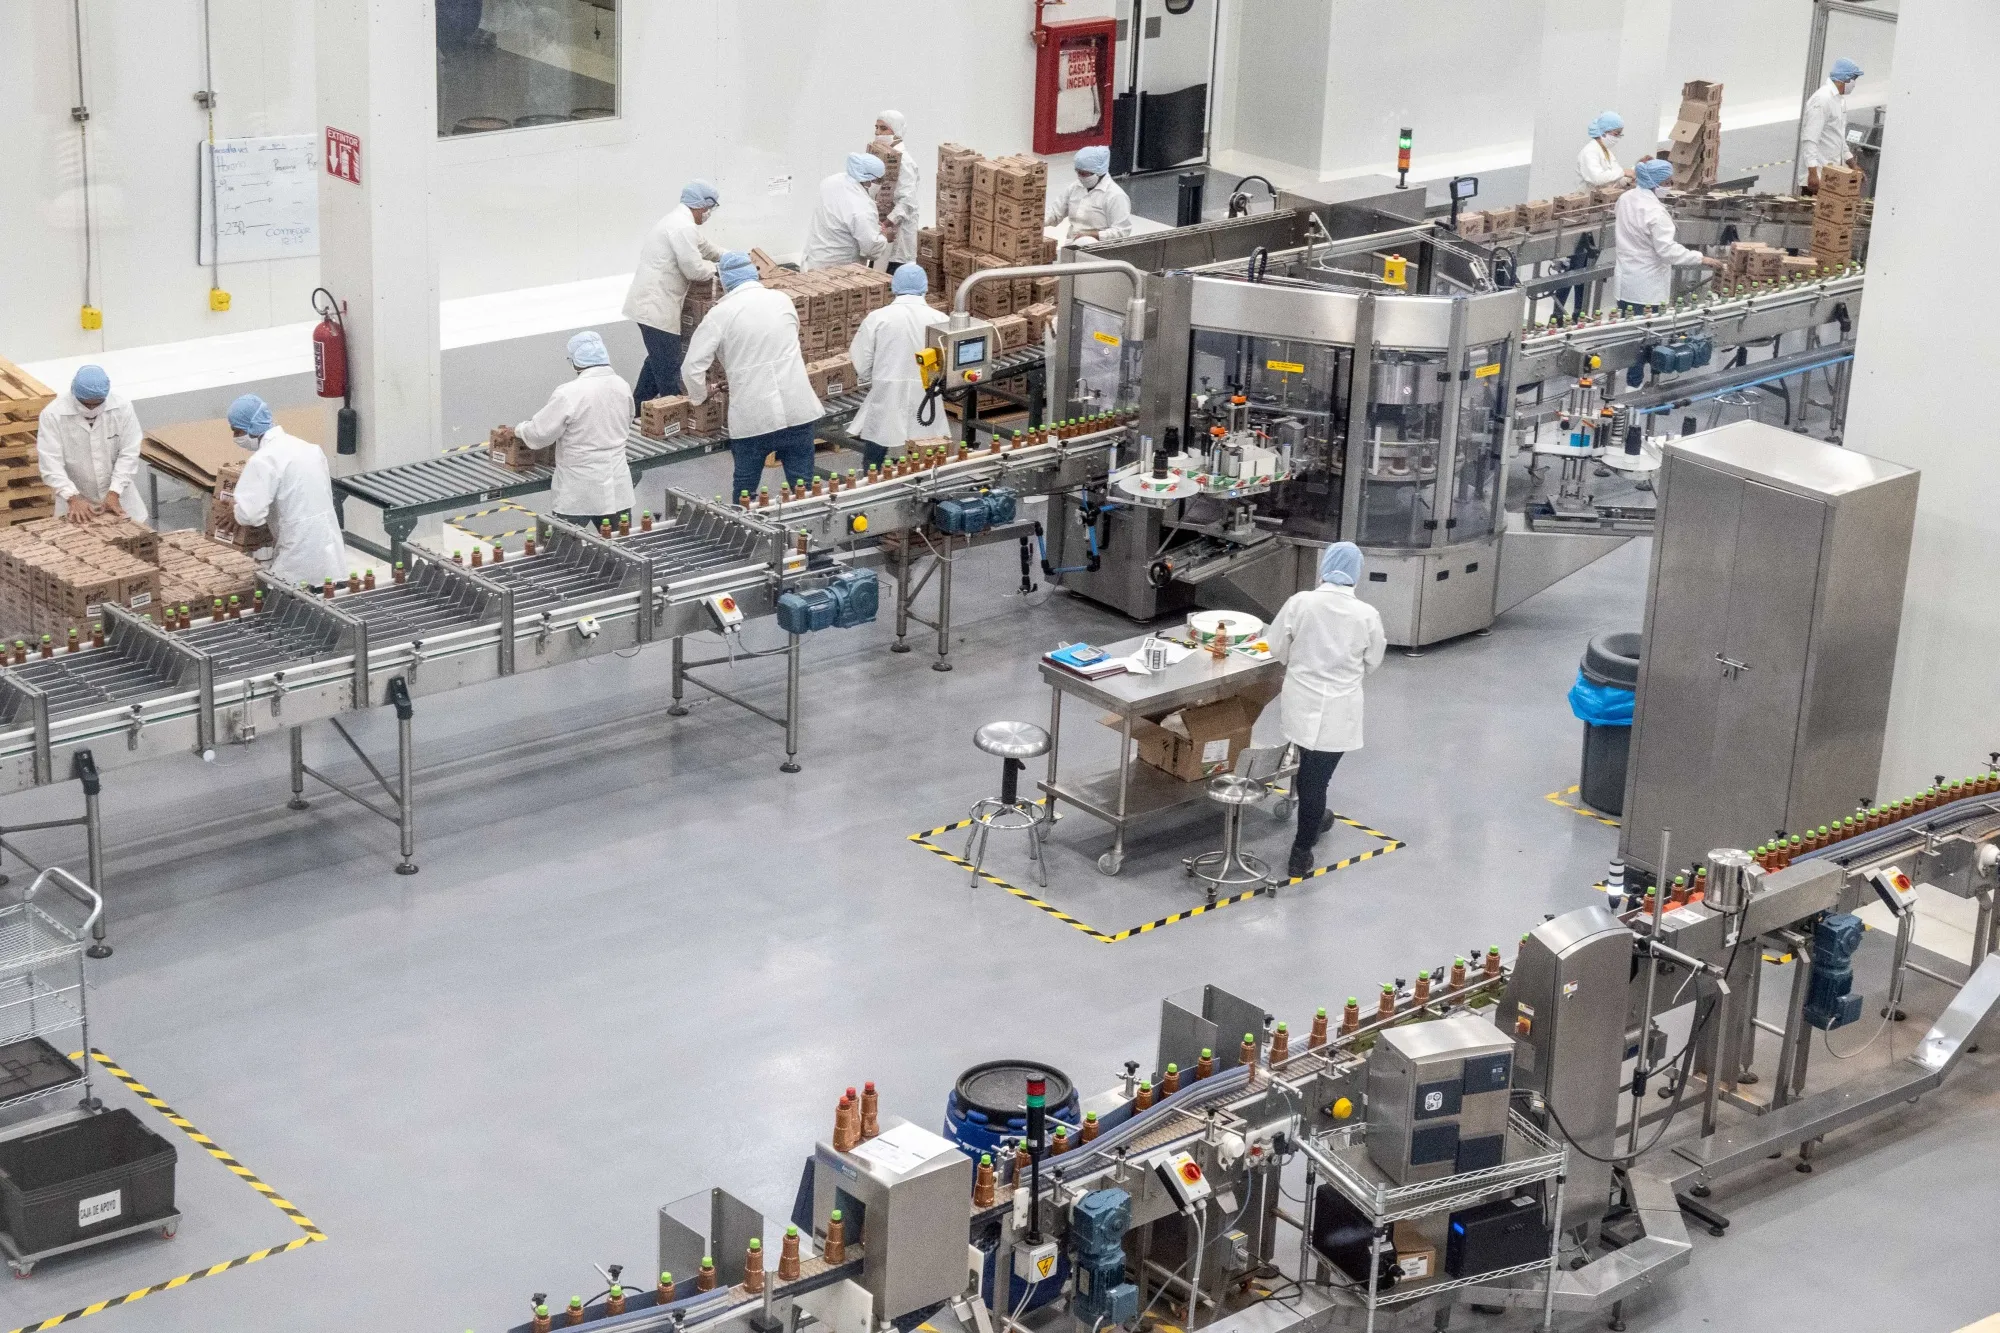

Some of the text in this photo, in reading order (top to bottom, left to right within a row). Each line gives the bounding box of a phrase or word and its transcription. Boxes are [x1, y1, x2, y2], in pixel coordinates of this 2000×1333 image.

[1069, 62, 1096, 76] CASO DE
[1066, 75, 1097, 89] INCENDIO
[327, 129, 359, 147] EXTINTOR
[80, 1199, 116, 1219] CAJA DE APOYO
